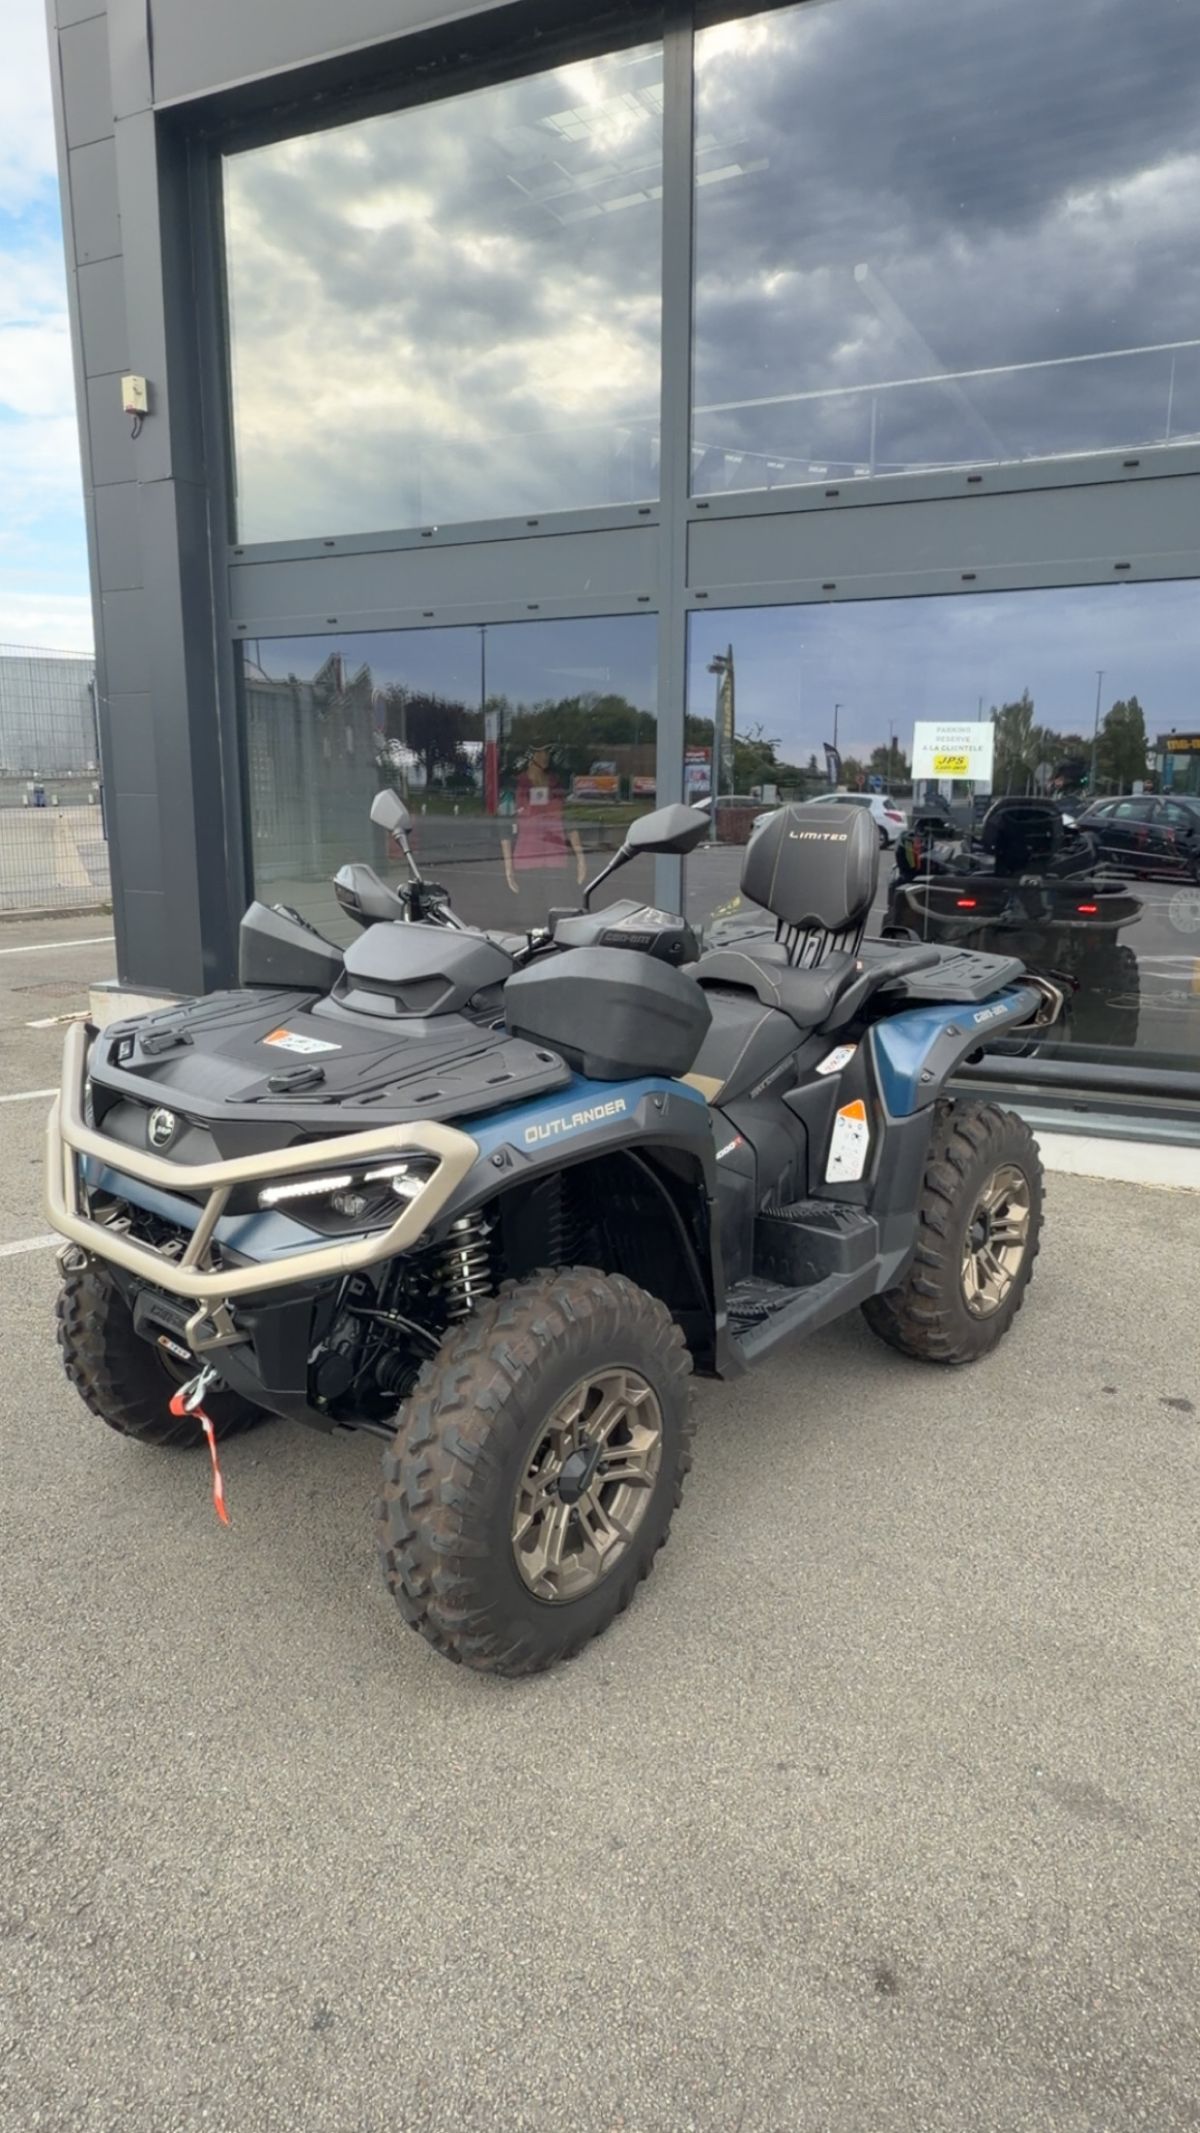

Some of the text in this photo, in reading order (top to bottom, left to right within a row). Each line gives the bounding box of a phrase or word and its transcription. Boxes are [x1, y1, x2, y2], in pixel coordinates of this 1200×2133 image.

[941, 744, 983, 752] CLIENTELE
[937, 756, 965, 765] JPS
[789, 831, 848, 841] LIMITED
[525, 1098, 626, 1144] OUTLANDER
